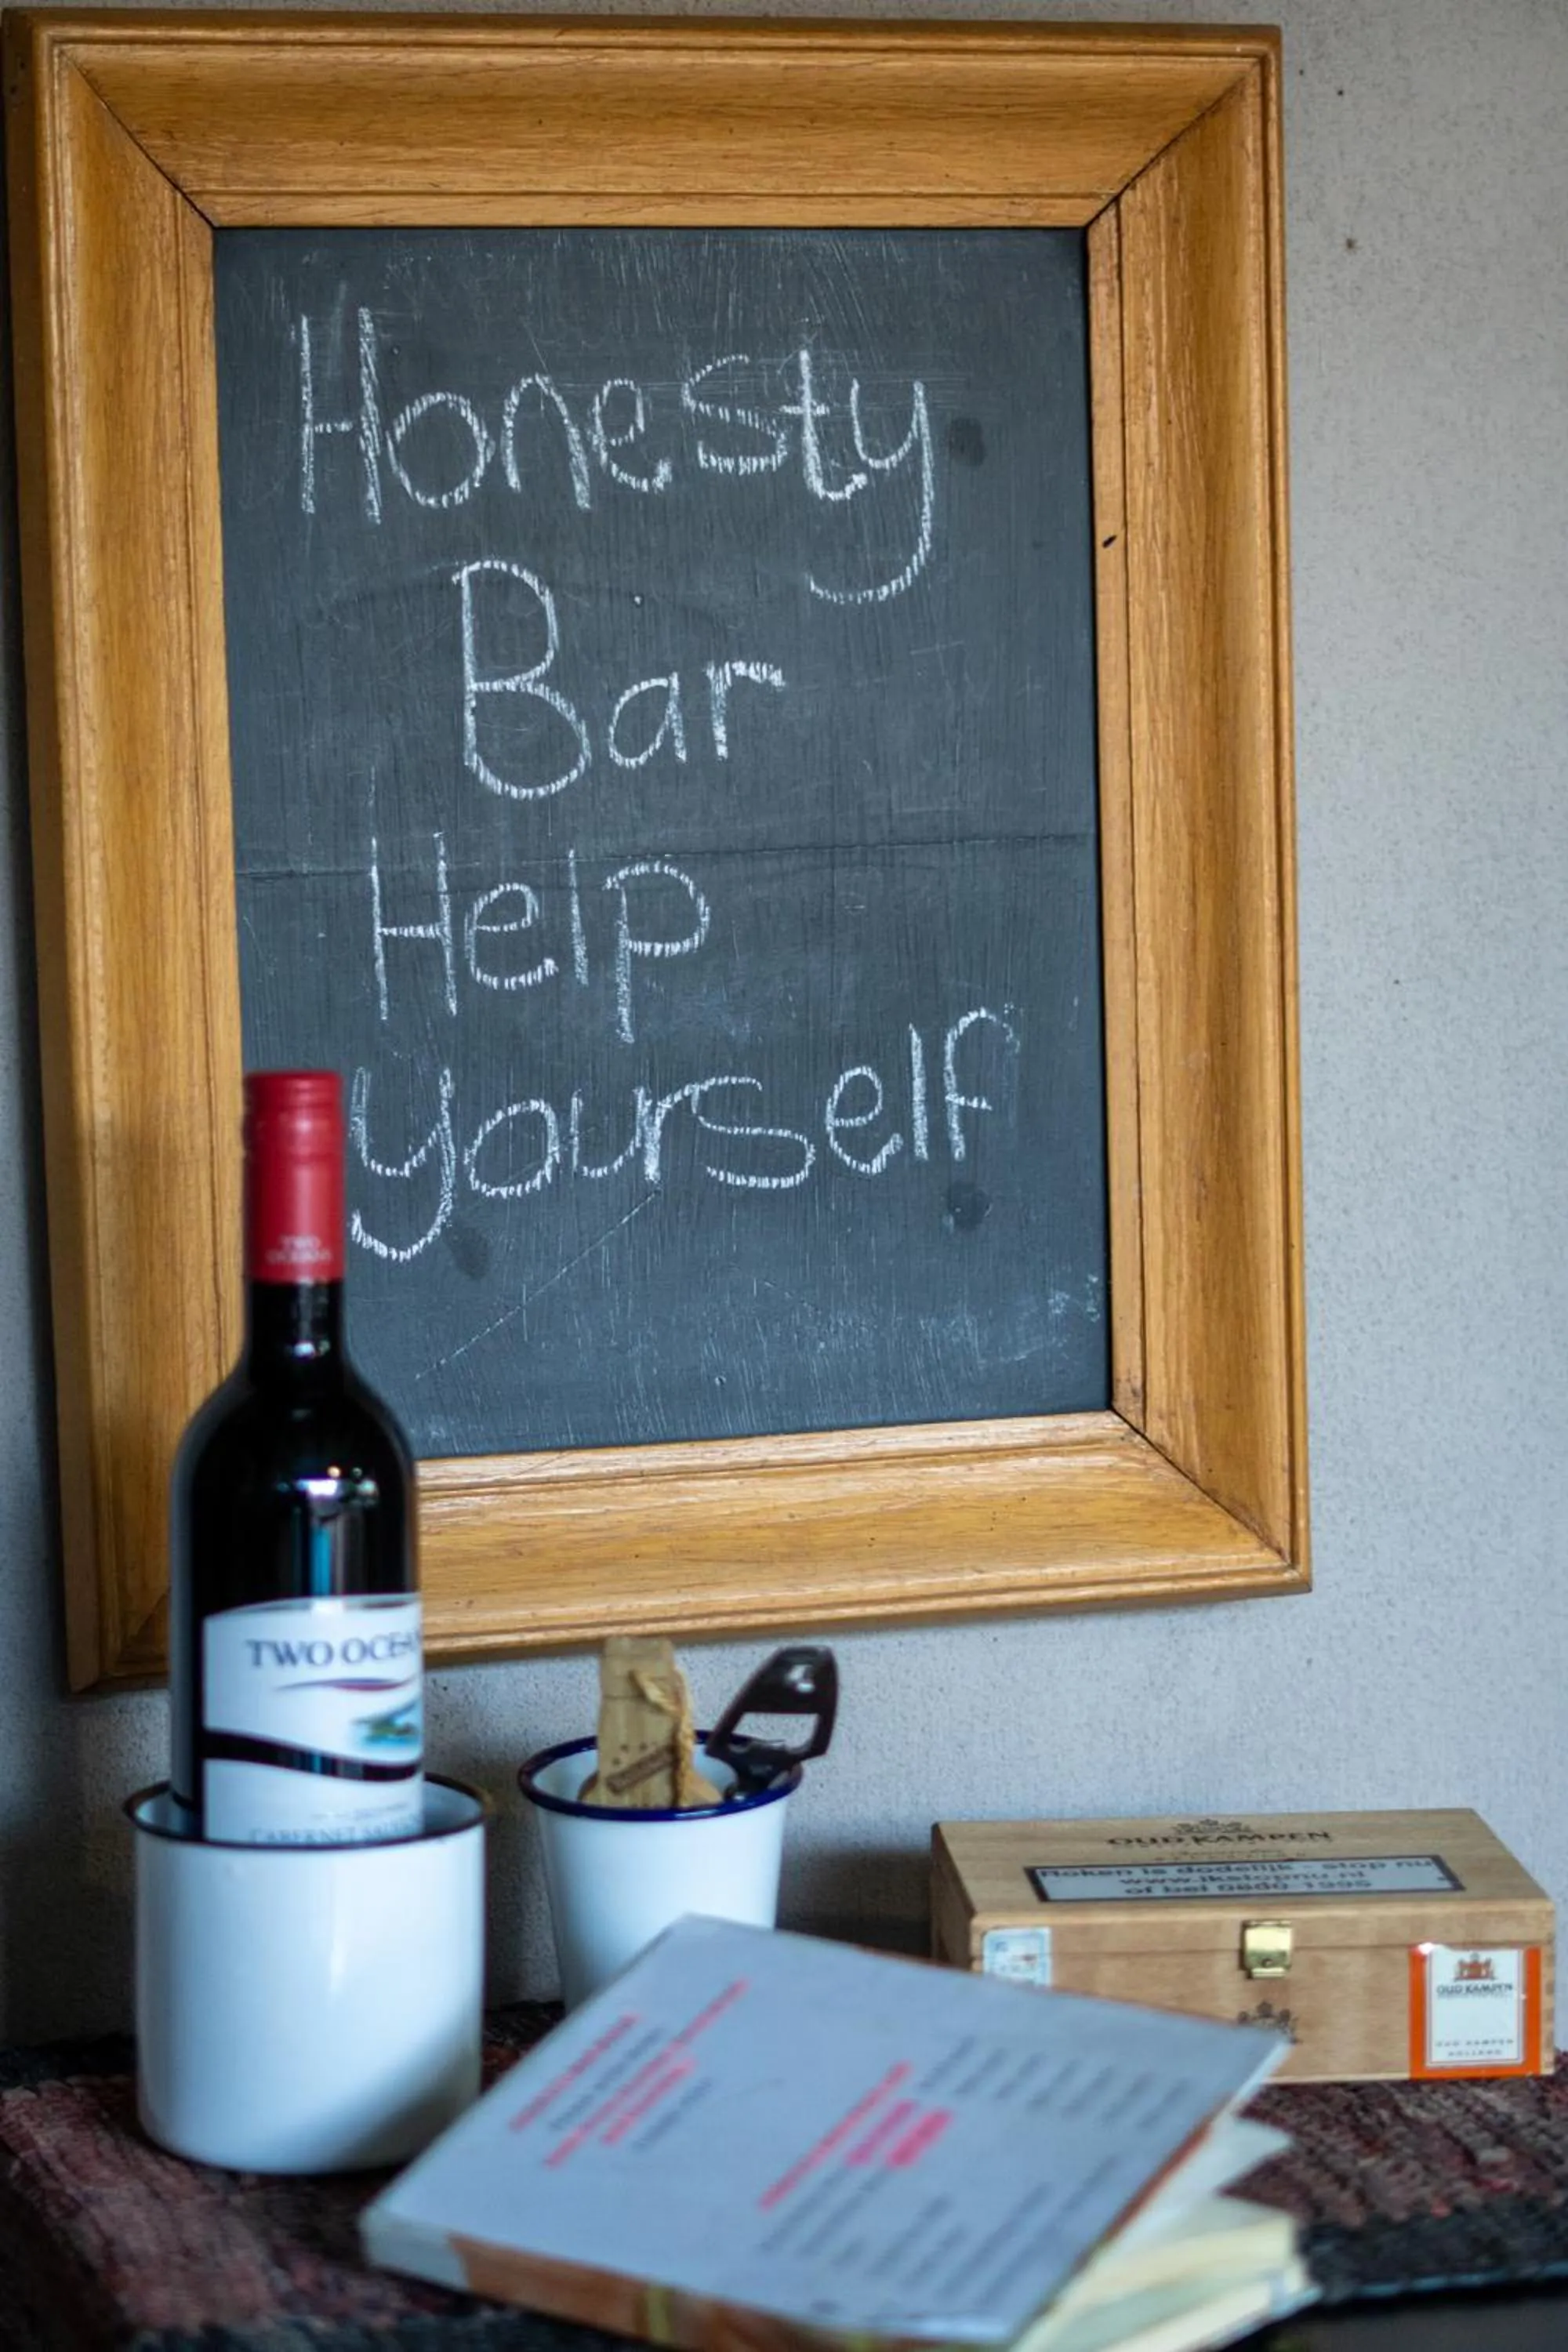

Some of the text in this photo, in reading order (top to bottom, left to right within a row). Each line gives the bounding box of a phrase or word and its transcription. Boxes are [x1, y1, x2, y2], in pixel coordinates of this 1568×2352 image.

[299, 307, 935, 604] Honesty
[452, 558, 786, 800] Bar
[370, 831, 710, 1044] Help
[245, 1638, 335, 1668] TWO
